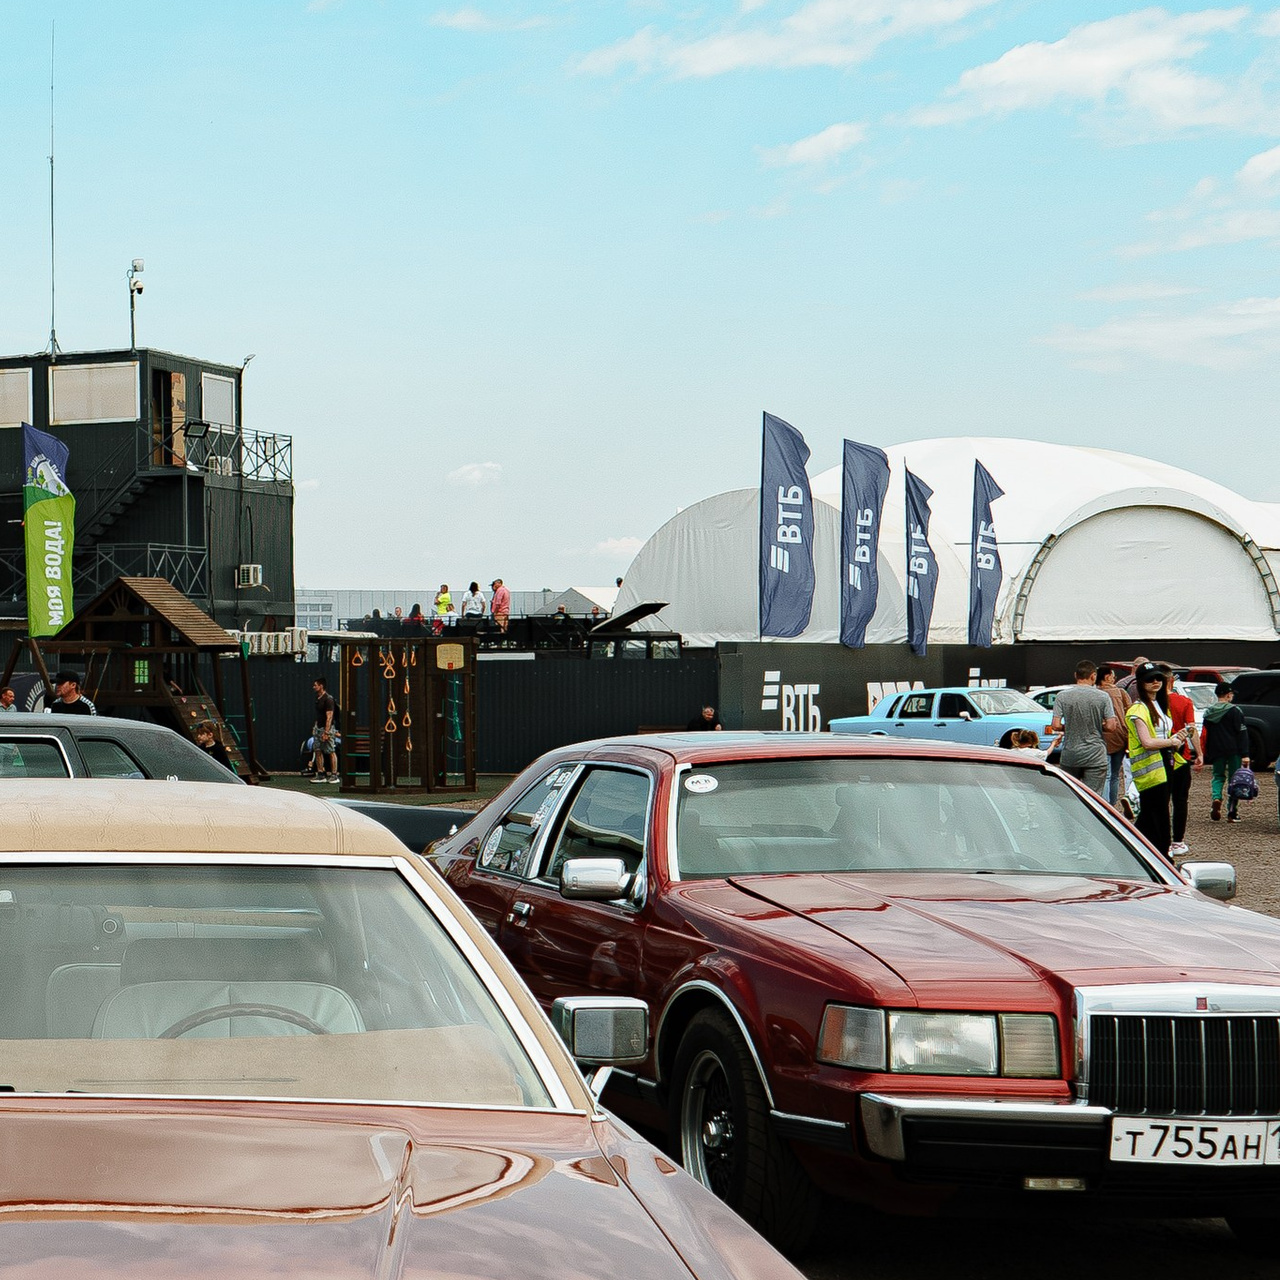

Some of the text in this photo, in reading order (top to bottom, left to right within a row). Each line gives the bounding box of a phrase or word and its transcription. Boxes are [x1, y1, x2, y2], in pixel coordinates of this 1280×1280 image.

[777, 484, 803, 544] ВТБ
[854, 507, 873, 563] ВТБ
[44, 520, 66, 627] МОЯ ВОДА!
